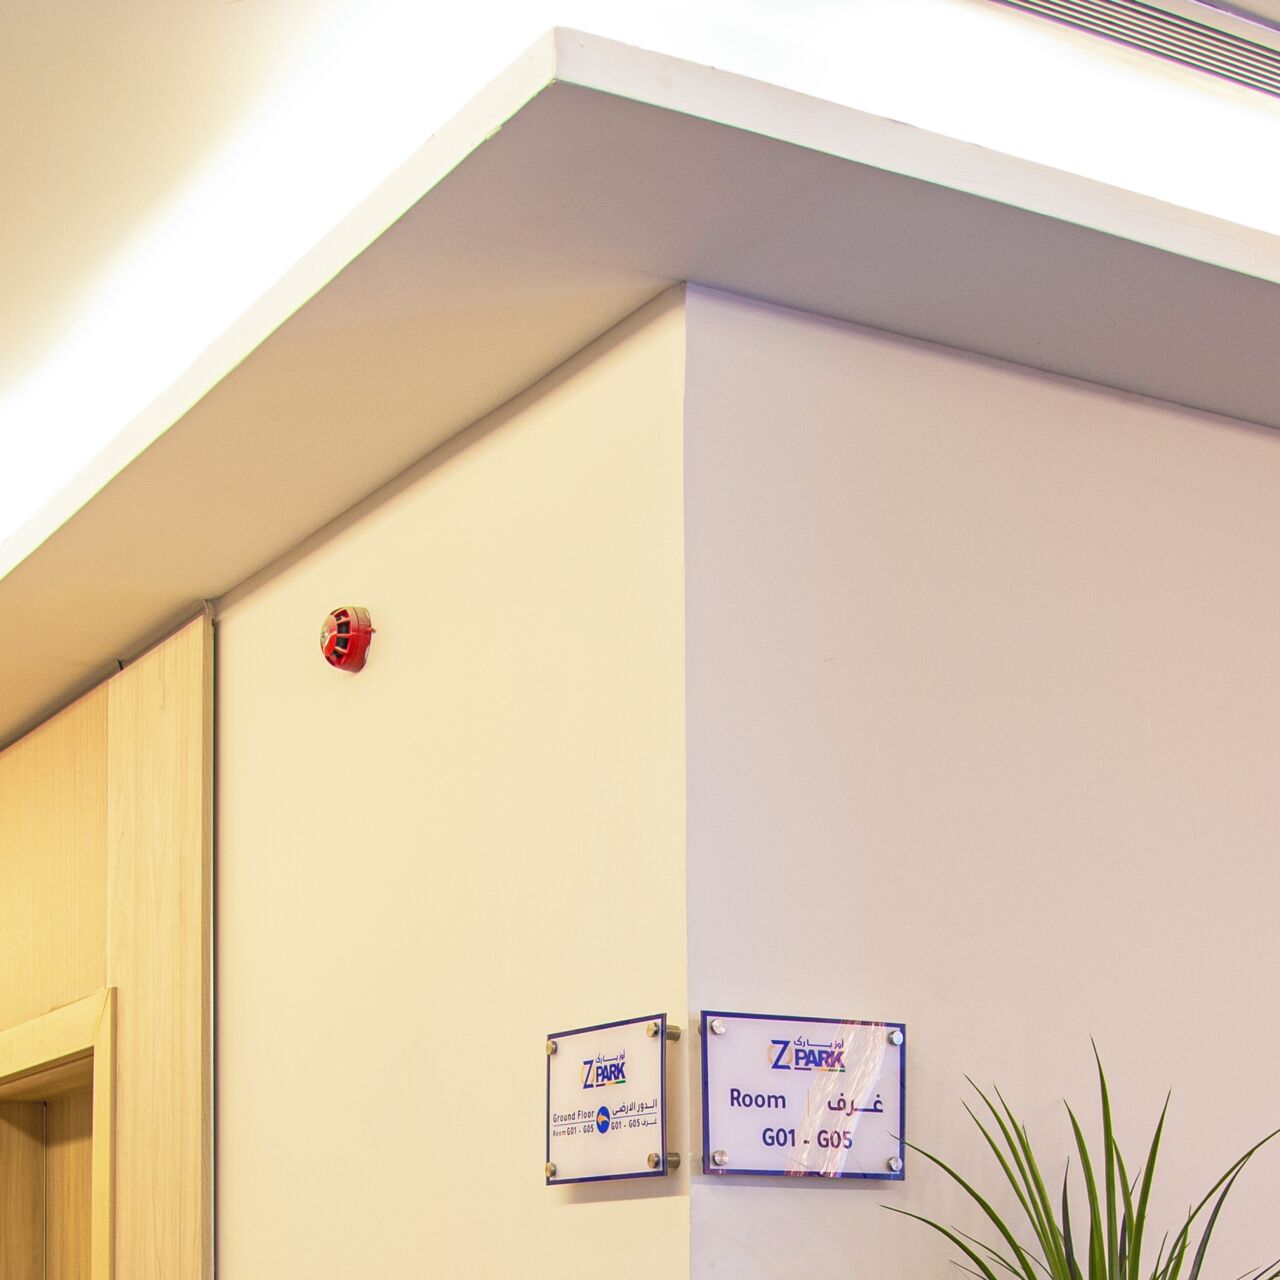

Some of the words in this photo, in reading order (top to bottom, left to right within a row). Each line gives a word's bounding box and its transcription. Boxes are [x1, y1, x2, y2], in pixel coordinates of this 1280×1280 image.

[730, 1088, 787, 1109] Room
[552, 1111, 576, 1123] Ground
[577, 1109, 595, 1120] Floor
[567, 1126, 577, 1136] G01
[583, 1124, 595, 1134] G05
[611, 1120, 622, 1130] G01
[628, 1118, 641, 1128] G05
[762, 1127, 796, 1147] G01
[817, 1129, 853, 1149] G05
